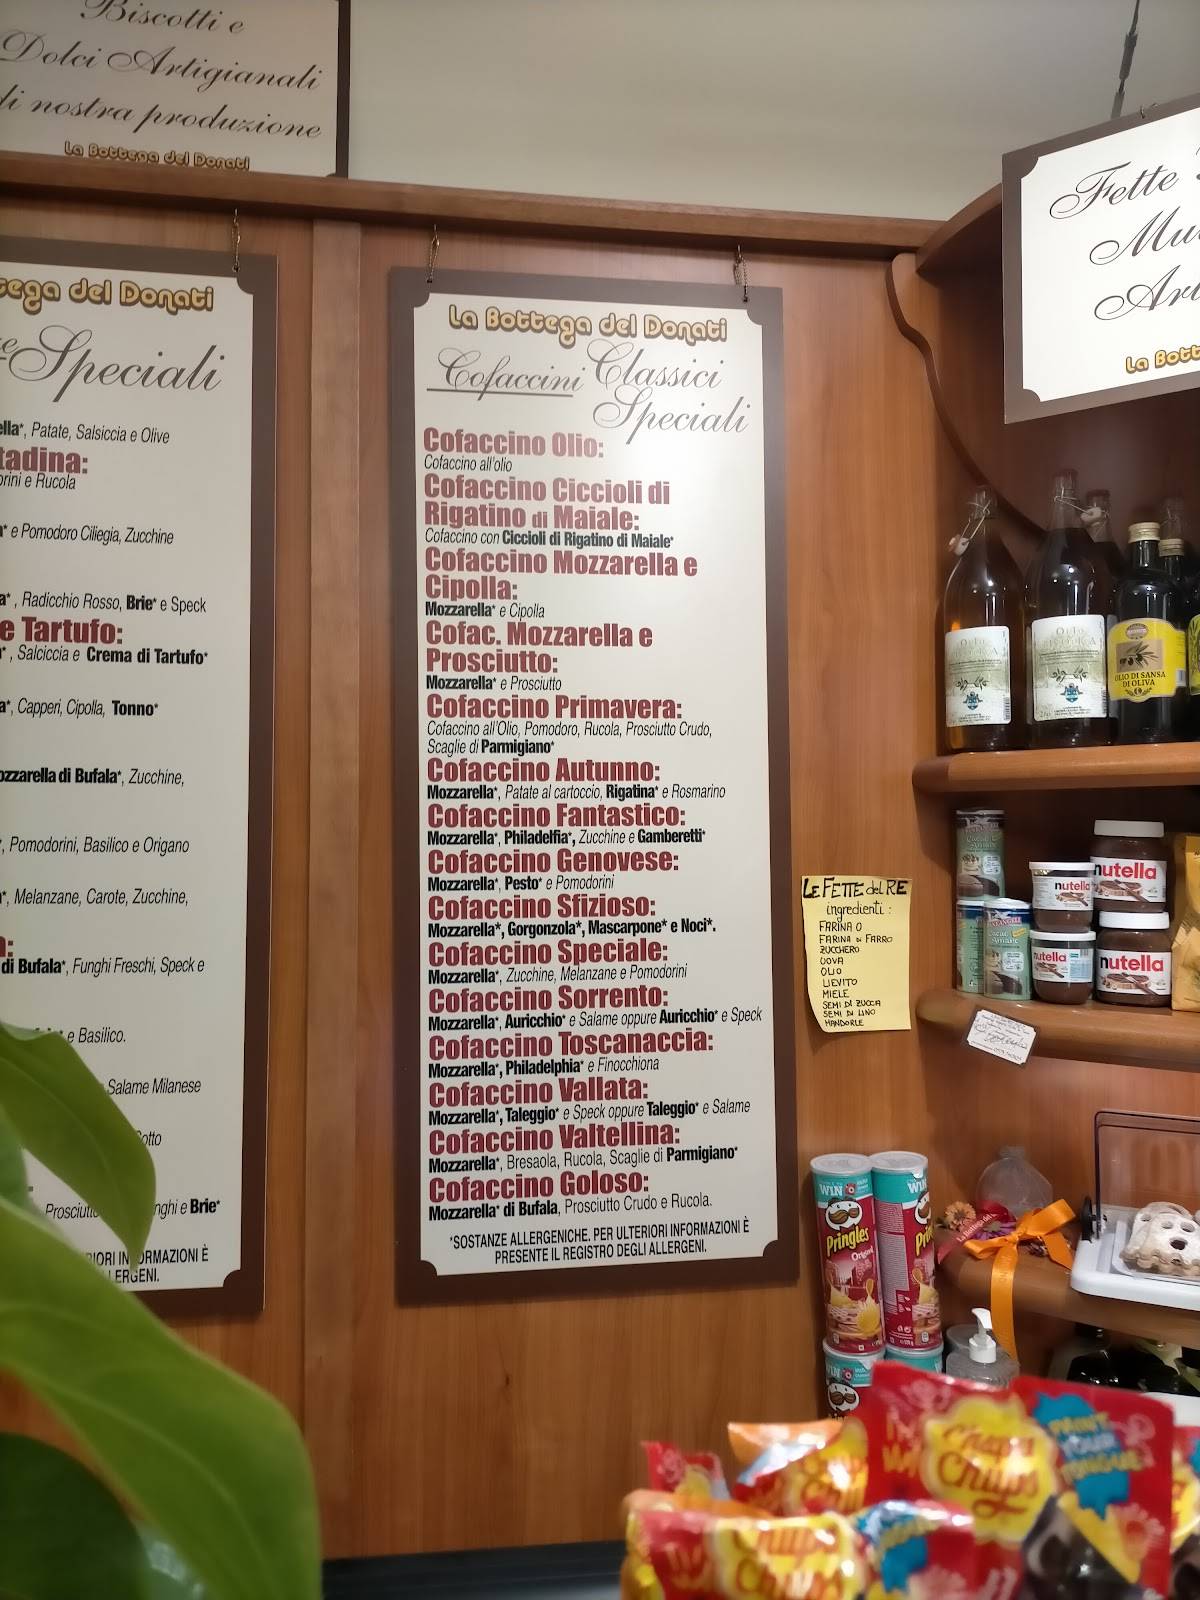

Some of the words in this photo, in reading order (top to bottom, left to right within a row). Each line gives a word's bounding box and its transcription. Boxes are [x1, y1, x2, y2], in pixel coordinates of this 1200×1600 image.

[229, 21, 244, 33] e
[0, 31, 102, 68] Dolci
[107, 46, 322, 93] Artigianali
[31, 97, 133, 121] nostra
[132, 104, 320, 137] produzione
[64, 141, 84, 157] La
[88, 143, 159, 165] Bottega
[164, 150, 190, 166] del
[193, 151, 250, 171] Donati
[1049, 161, 1180, 220] Fette
[69, 278, 112, 305] del
[120, 280, 214, 316] Donati
[448, 304, 478, 329] La
[485, 306, 592, 348] Bottega
[599, 313, 638, 337] del
[644, 315, 728, 346] Donati
[9, 324, 225, 403] Speciali
[437, 345, 587, 401] Cofaccini
[586, 338, 724, 390] Classici
[1125, 355, 1149, 374] La
[592, 384, 752, 445] Speciali
[31, 421, 71, 441] Patate,
[76, 423, 127, 442] Salsiccia
[130, 430, 137, 442] e
[141, 427, 170, 444] Olive
[422, 427, 546, 455] Cofaccino
[551, 431, 604, 458] Olio:
[424, 453, 477, 471] Cofaccino
[479, 456, 512, 472] all'olio
[24, 475, 32, 488] e
[35, 472, 76, 490] Rucola
[423, 473, 547, 504] Cofaccino
[552, 479, 642, 508] Ciccioli
[647, 481, 670, 505] di
[425, 502, 527, 530] Rigatino
[532, 511, 548, 529] di
[553, 504, 639, 530] Maiale:
[11, 526, 18, 538] e
[21, 522, 78, 541] Pomodoro
[80, 525, 121, 546] Ciliegia,
[124, 527, 174, 544] Zucchine
[425, 527, 478, 544] Cofaccino
[480, 532, 500, 544] con
[502, 530, 546, 545] Ciccioli
[549, 531, 561, 546] di
[564, 531, 614, 550] Rigatino
[616, 533, 628, 547] di
[424, 546, 547, 577] Cofaccino
[552, 550, 678, 576] Mozzarella
[684, 556, 697, 577] e
[424, 571, 521, 601] Cipolla:
[22, 591, 79, 609] Radicchio
[83, 593, 122, 612] Rosso,
[160, 599, 167, 612] e
[171, 596, 206, 616] Speck
[499, 606, 506, 618] e
[509, 602, 545, 622] Cipolla
[22, 616, 123, 645] Tartufo:
[426, 620, 500, 649] Cofac.
[507, 623, 633, 648] Mozzarella
[639, 627, 652, 647] e
[426, 647, 559, 674] Prosciutto:
[1114, 673, 1130, 682] OLIO
[1140, 671, 1166, 679] SANSA
[1131, 679, 1156, 687] OLIVA
[426, 693, 549, 719] Cofaccino
[555, 695, 682, 720] Primavera:
[427, 720, 480, 736] Cofaccino
[483, 720, 520, 736] all'Olio,
[524, 721, 580, 738] Pomodoro,
[584, 721, 622, 738] Rucola,
[626, 721, 676, 736] Prosciutto
[679, 721, 712, 738] Crudo,
[427, 757, 551, 783] Cofaccino
[555, 757, 660, 782] Autunno:
[427, 804, 551, 829] Cofaccino
[556, 803, 686, 827] Fantastico:
[9, 836, 79, 854] Pomodorini,
[83, 836, 129, 853] Basilico
[132, 840, 140, 853] e
[143, 836, 190, 857] Origano
[428, 848, 551, 874] Cofaccino
[556, 848, 679, 873] Genovese:
[865, 880, 884, 895] del
[886, 880, 909, 895] RE
[428, 895, 551, 921] Cofaccino
[556, 893, 656, 918] Sfizioso:
[819, 920, 853, 933] FARINA
[819, 934, 852, 945] FARINA
[865, 933, 893, 944] FARRO
[428, 942, 553, 966] Cofaccino
[556, 937, 668, 965] Speciale:
[819, 945, 860, 954] ZUCCHERO
[1033, 951, 1067, 962] nutella
[820, 967, 842, 976] OLIO
[1100, 954, 1164, 972] nutella
[822, 978, 858, 988] LIEVITO
[822, 989, 850, 999] MIELE
[429, 989, 552, 1013] Cofaccino
[558, 985, 668, 1009] Sorrento:
[822, 1000, 842, 1010] SEMI
[429, 1034, 553, 1061] Cofaccino
[559, 1031, 713, 1056] Toscanaccia:
[108, 1078, 149, 1096] Salame
[152, 1077, 201, 1094] Milanese
[429, 1080, 553, 1108] Cofaccino
[559, 1077, 648, 1102] Vallata:
[429, 1127, 554, 1156] Cofaccino
[559, 1122, 680, 1149] Valtellina:
[429, 1177, 554, 1203] Cofaccino
[560, 1170, 649, 1196] Goloso:
[510, 1228, 591, 1246] ALLERGENICHE.
[593, 1227, 613, 1241] PER
[616, 1224, 668, 1240] ULTERIORI
[670, 1220, 740, 1237] INFORMAZIONI
[743, 1215, 749, 1233] È
[826, 1226, 869, 1257] Pringles
[495, 1248, 548, 1264] PRESENTE
[551, 1247, 560, 1261] IL
[563, 1244, 614, 1260] REGISTRO
[617, 1242, 646, 1257] DEGLI
[649, 1239, 707, 1255] ALLERGENI.
